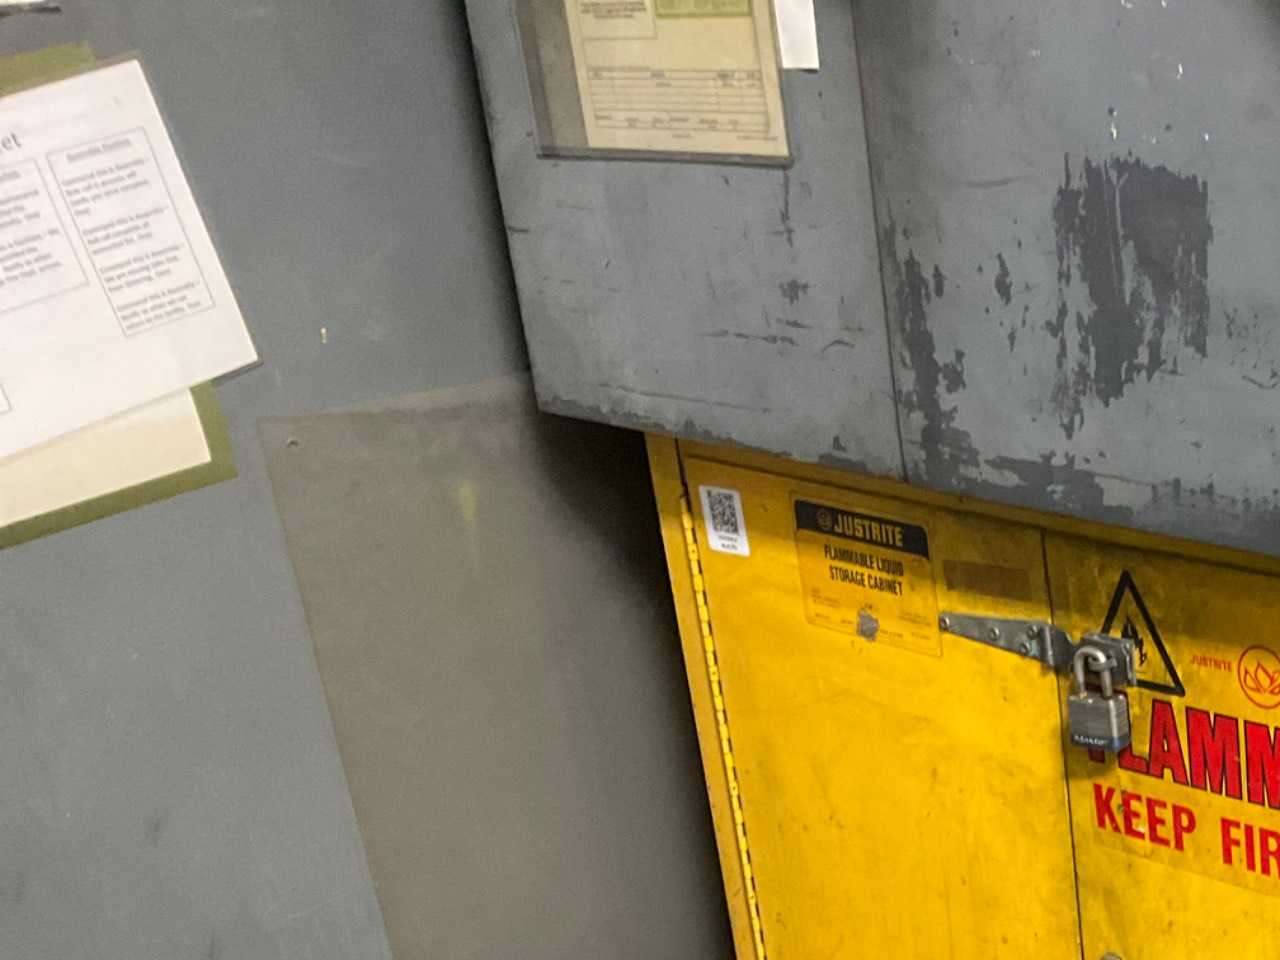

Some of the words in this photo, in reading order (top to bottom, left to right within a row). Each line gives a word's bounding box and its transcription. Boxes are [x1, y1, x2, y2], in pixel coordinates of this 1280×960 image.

[834, 513, 904, 548] JUSTRITE
[824, 544, 874, 570] FLAMMABLE
[876, 556, 904, 577] LIQUID
[828, 564, 867, 588] STORAGE
[867, 575, 903, 596] CABINET
[1190, 654, 1233, 673] JUSTRITE
[1092, 782, 1197, 852] KEEP
